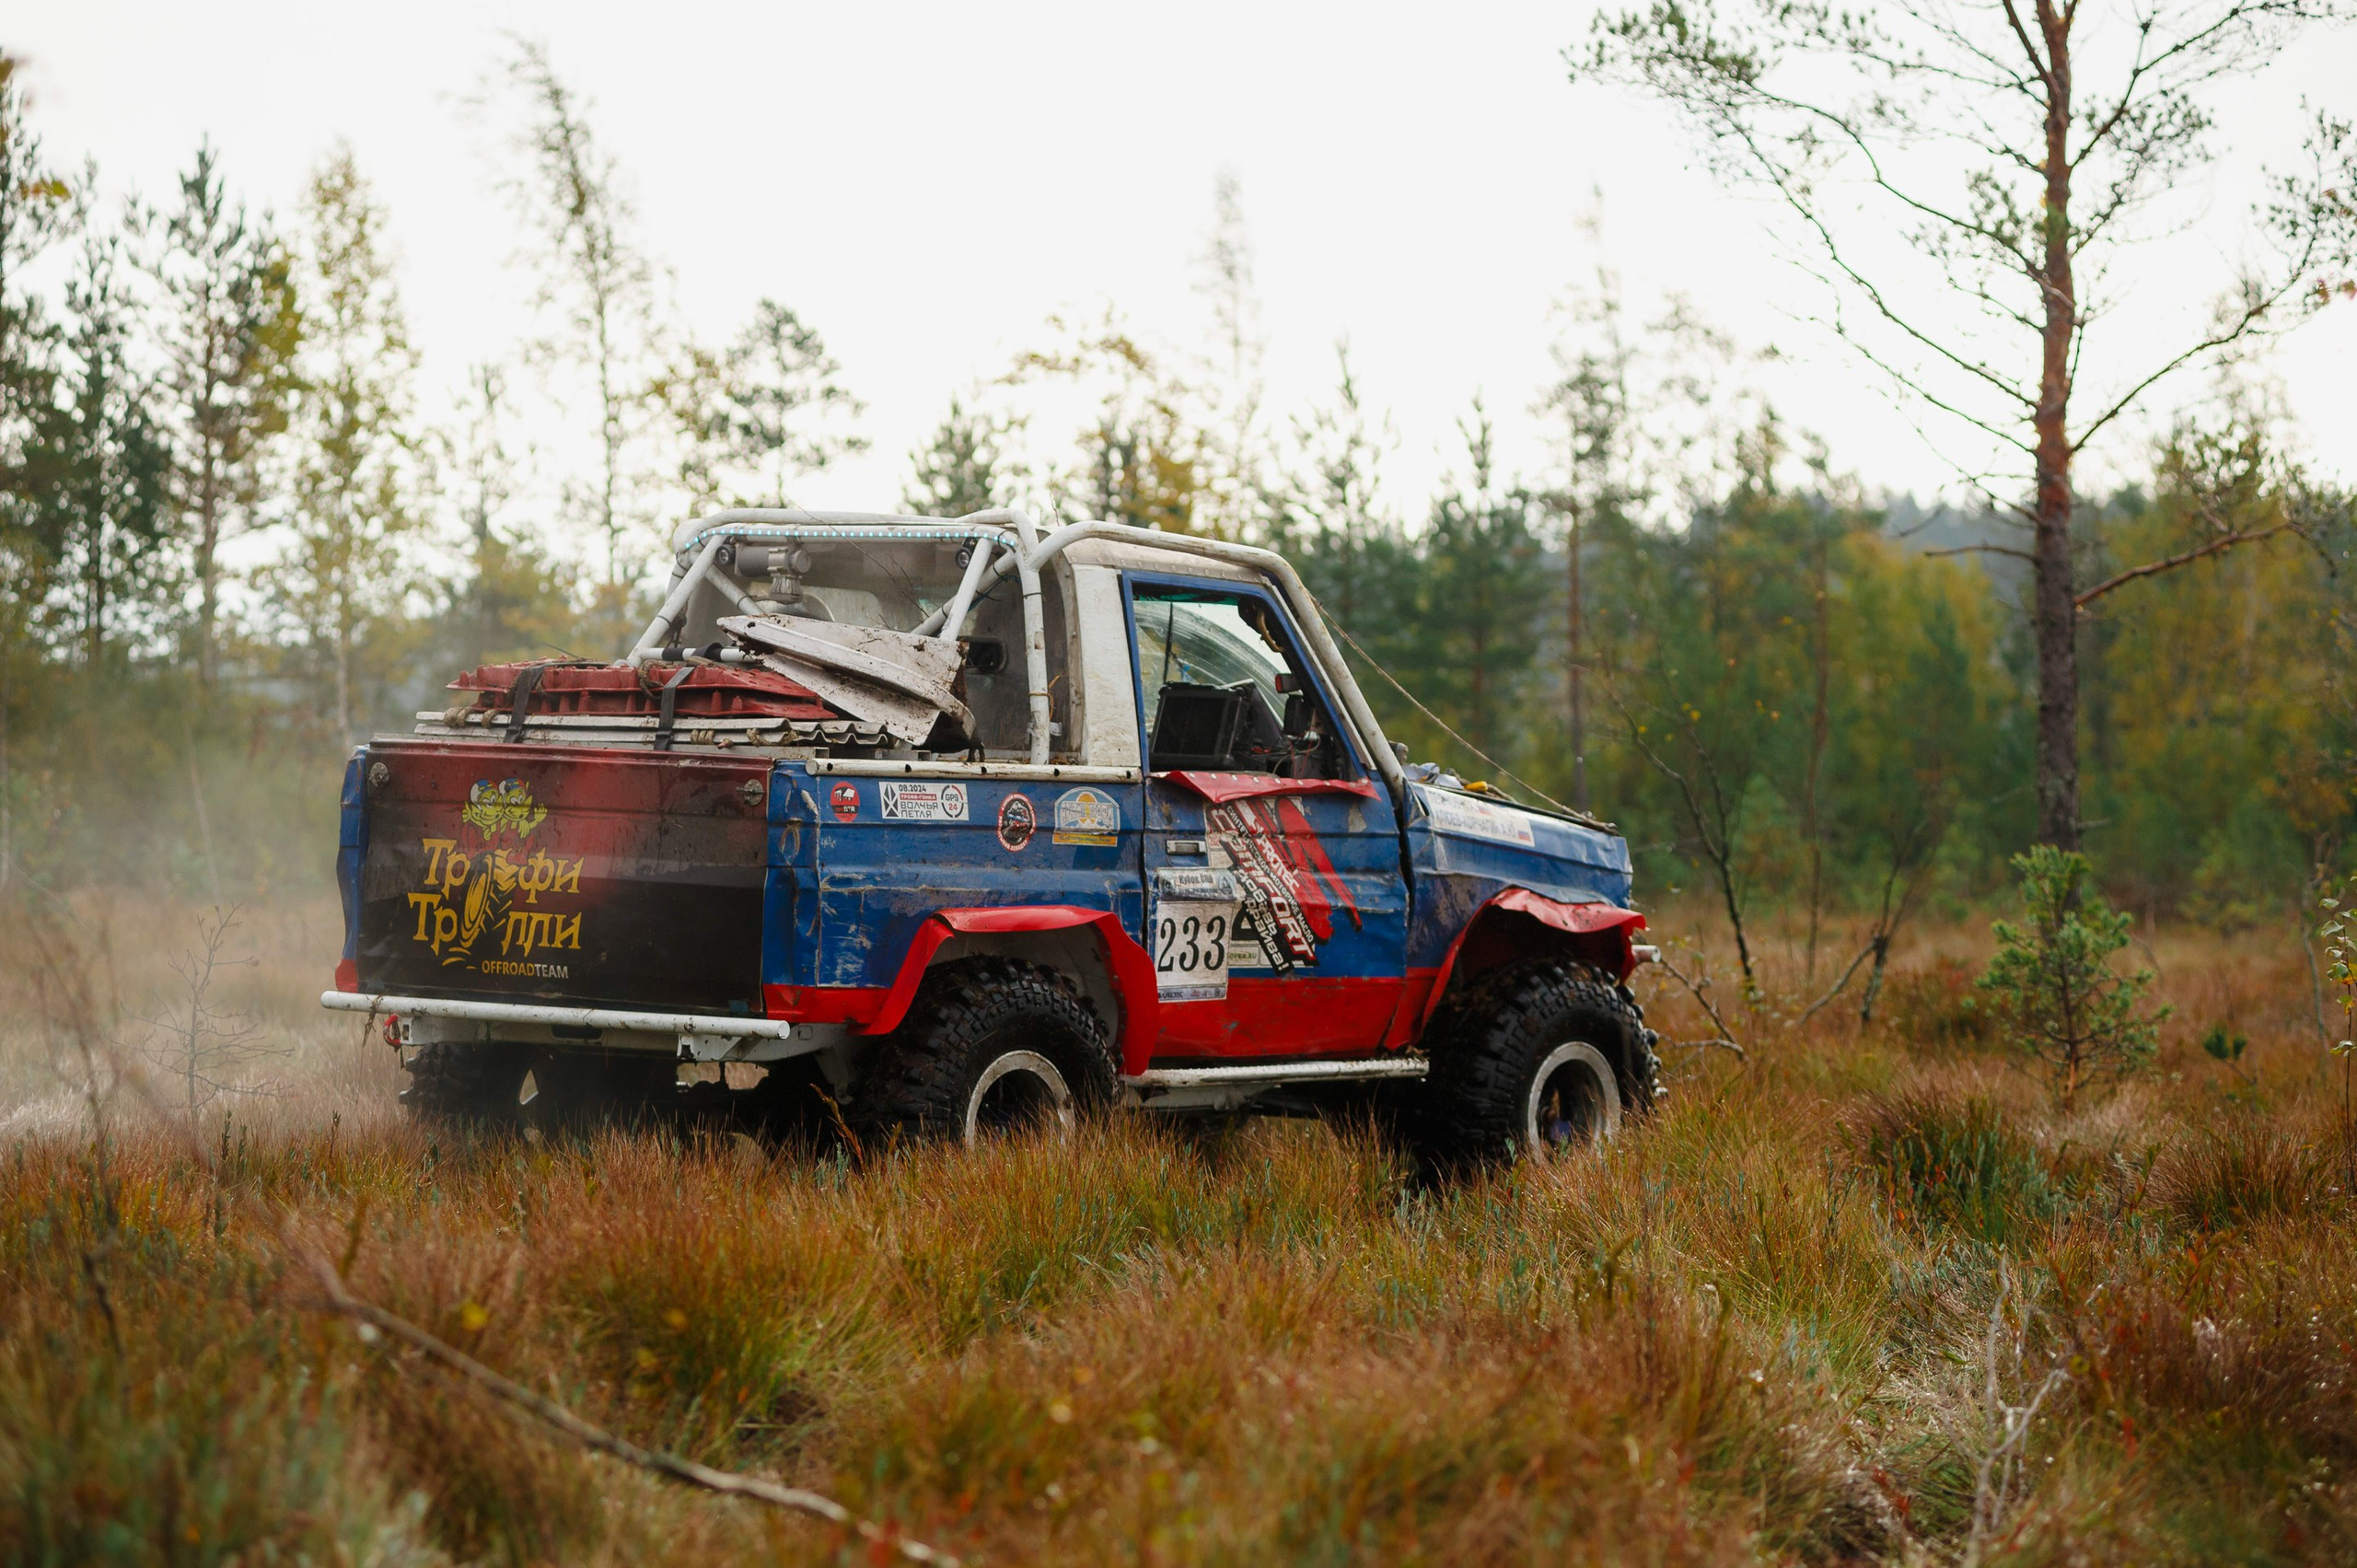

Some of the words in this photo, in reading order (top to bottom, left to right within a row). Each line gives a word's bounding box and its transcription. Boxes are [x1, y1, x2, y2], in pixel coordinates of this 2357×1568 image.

[899, 784, 927, 793] 08.2024
[946, 794, 959, 802] GPS
[900, 801, 938, 810] ВОЛЧЬЯ
[948, 803, 958, 811] 24
[901, 809, 933, 819] ПЕТЛЯ
[1270, 873, 1301, 916] МОТОРНОЕ
[1296, 912, 1315, 943] МАСЛО
[1157, 915, 1226, 972] 233
[482, 959, 569, 980] OFFROADTEAM
